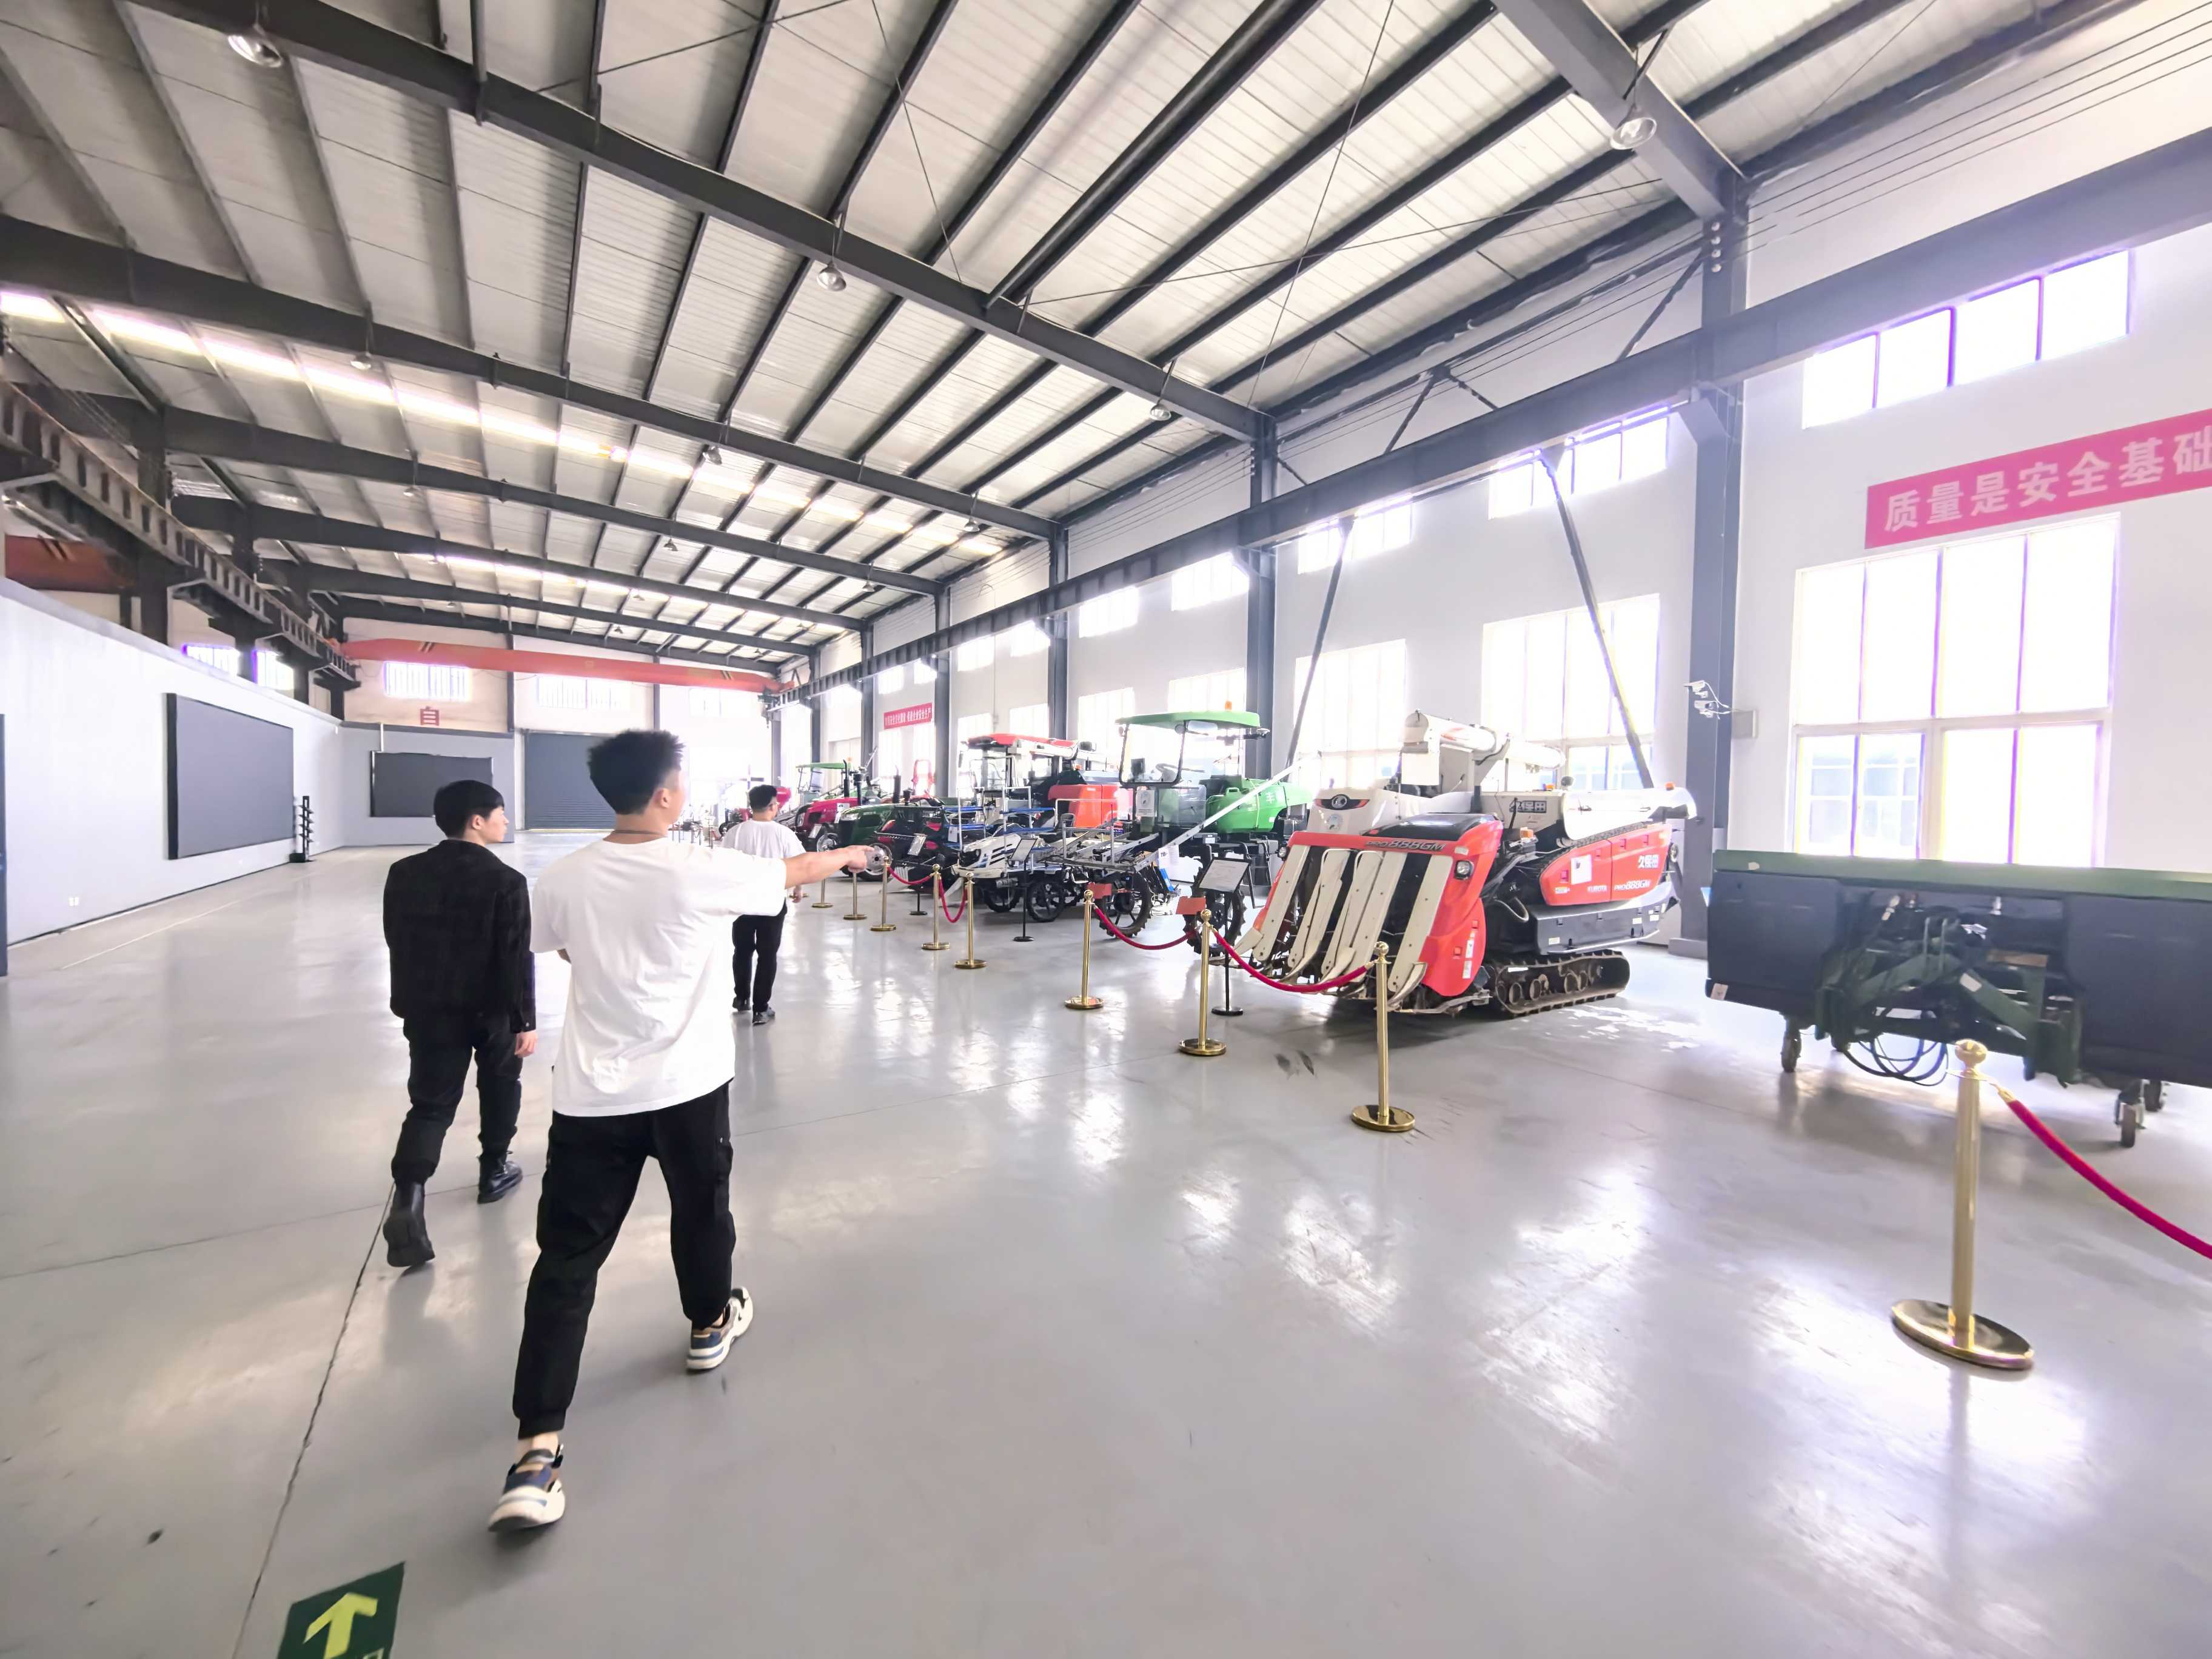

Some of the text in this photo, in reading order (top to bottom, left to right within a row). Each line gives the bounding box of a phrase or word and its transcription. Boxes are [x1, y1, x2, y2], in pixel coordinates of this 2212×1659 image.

[1884, 425, 2212, 532] 质量是安全基础
[420, 706, 440, 726] 自
[1638, 855, 1658, 868] 久保田
